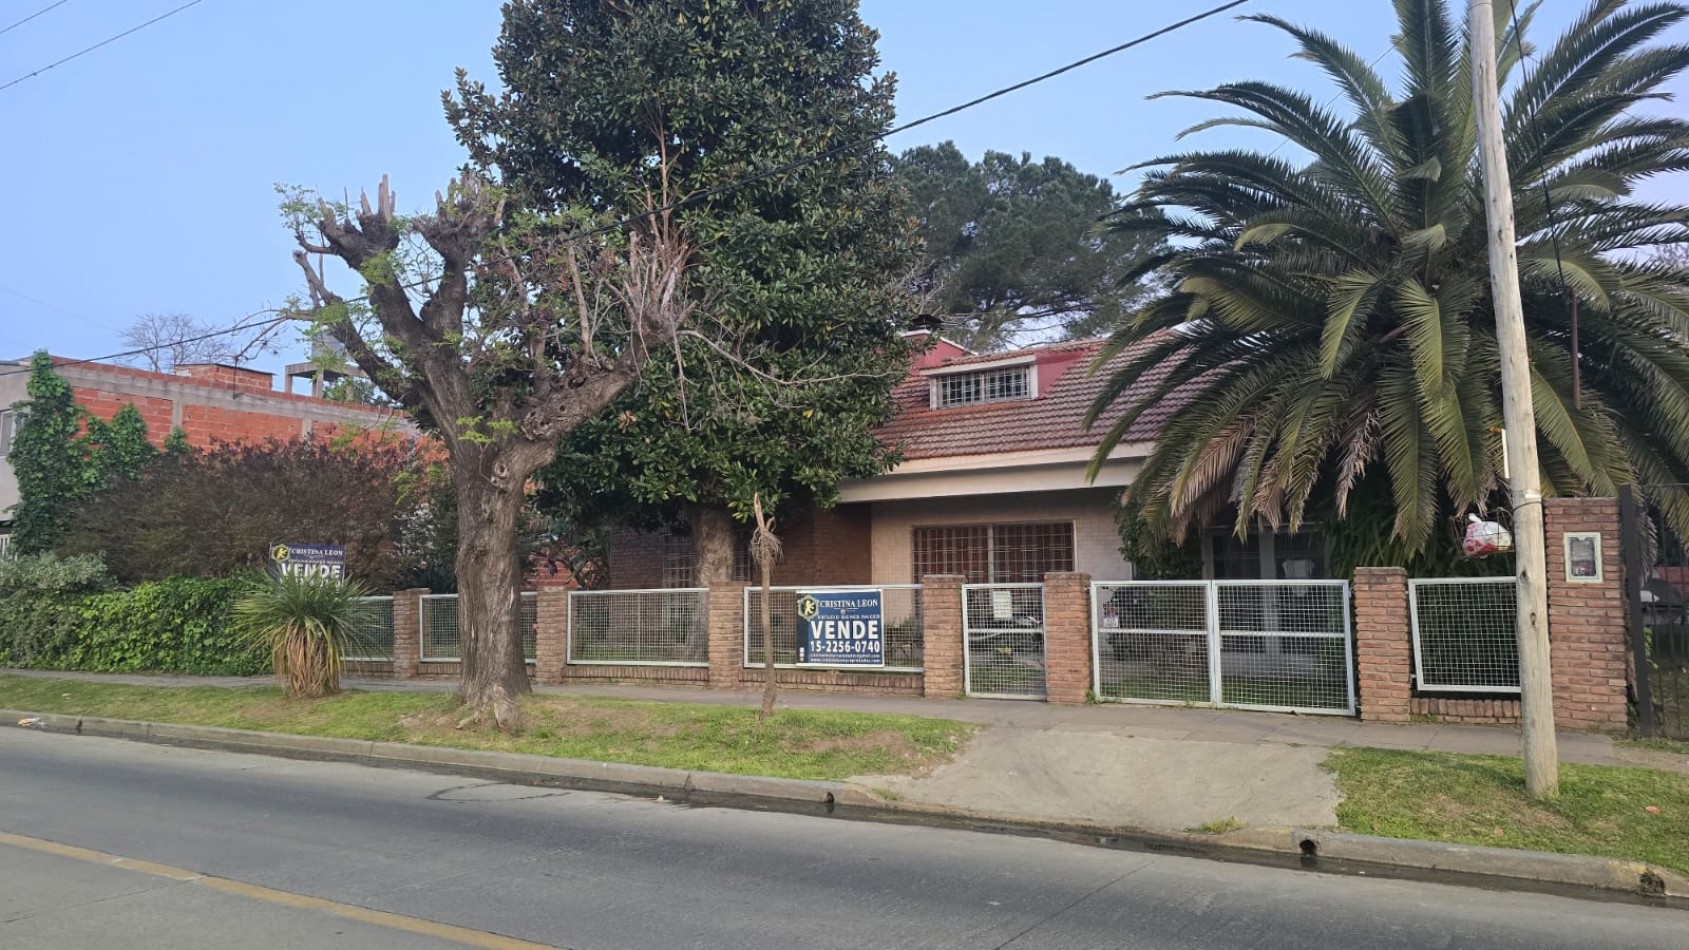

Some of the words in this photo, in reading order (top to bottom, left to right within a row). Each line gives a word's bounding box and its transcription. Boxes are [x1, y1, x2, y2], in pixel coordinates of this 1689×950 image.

[281, 563, 341, 578] VENDE
[820, 600, 856, 608] CRISTINA
[857, 599, 878, 607] LEON
[811, 620, 879, 639] VENDE
[810, 641, 880, 652] 15-2256-0740
